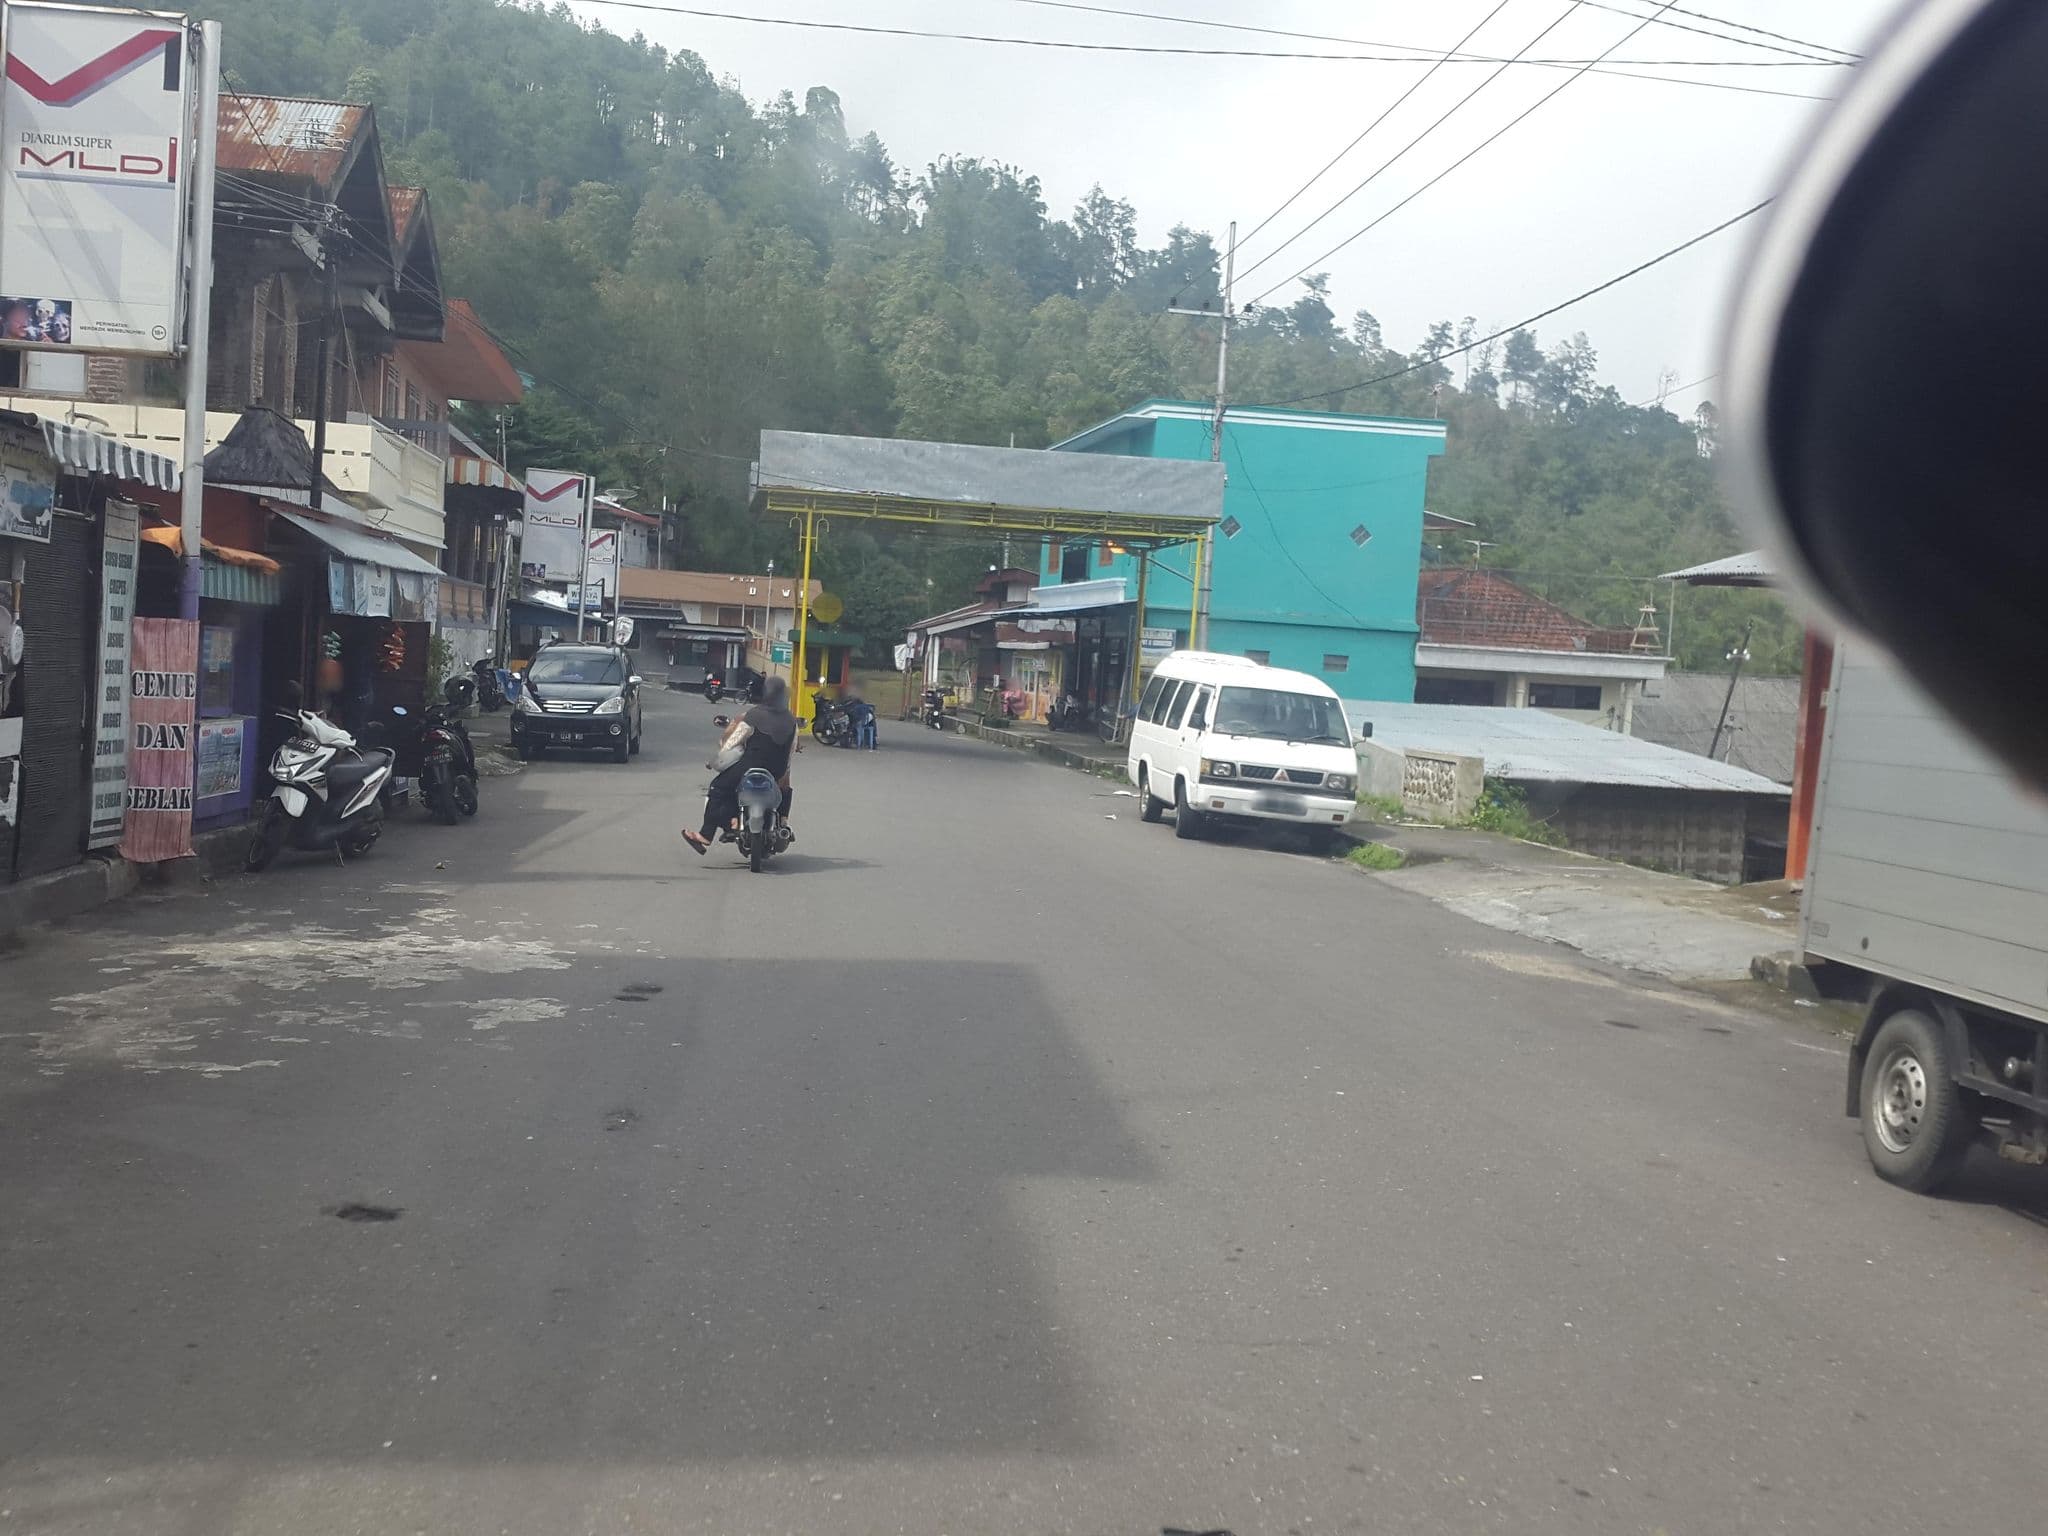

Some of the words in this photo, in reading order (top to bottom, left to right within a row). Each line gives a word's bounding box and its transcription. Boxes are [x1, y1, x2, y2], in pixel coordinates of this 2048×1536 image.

[21, 132, 72, 147] DJARUM
[73, 136, 112, 150] SUPER
[131, 670, 196, 699] CEMUE
[135, 722, 188, 750] DAN
